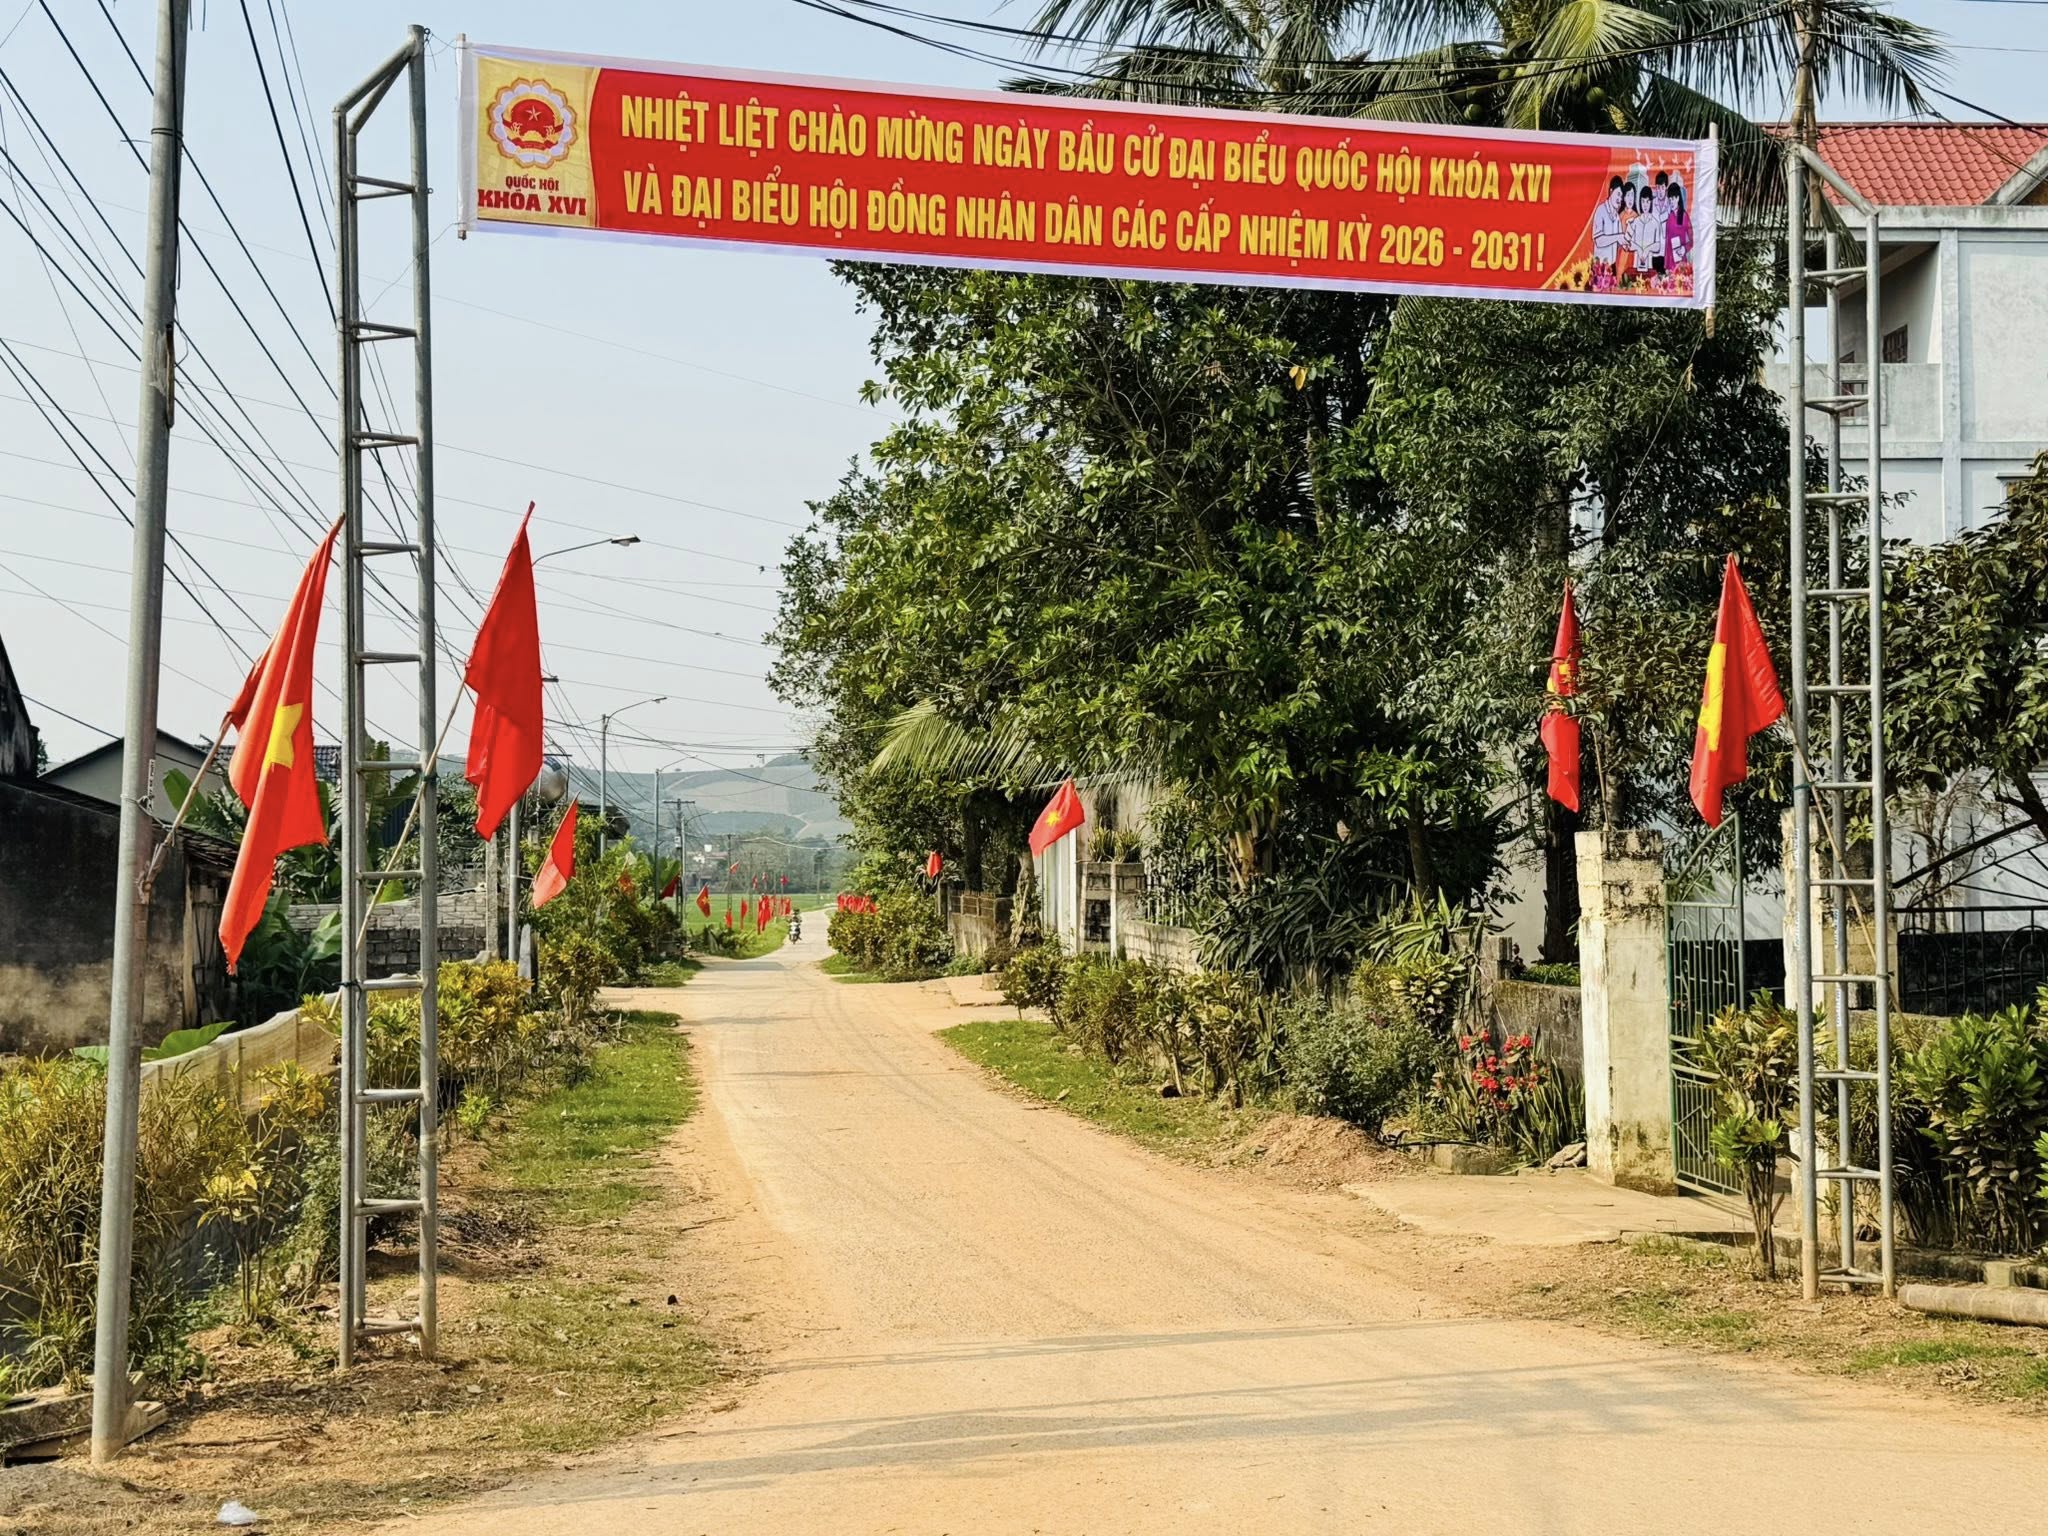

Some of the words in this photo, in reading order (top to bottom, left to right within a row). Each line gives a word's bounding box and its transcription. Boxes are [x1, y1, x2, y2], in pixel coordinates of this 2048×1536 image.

[621, 90, 710, 152] NHIỆT
[719, 96, 779, 158] LIỆT
[788, 104, 867, 157] CHÀO
[876, 110, 964, 164] MỪNG
[973, 118, 1050, 170] NGÀY
[1058, 119, 1115, 175] BẦU
[1123, 123, 1165, 178] CỬ
[1166, 137, 1216, 189] ĐẠI
[1223, 129, 1287, 186] BIỂU
[1295, 137, 1368, 192] QUỐC
[1376, 146, 1421, 204] HỘI
[1428, 150, 1500, 200] KHÓA
[1507, 162, 1552, 203] XVI
[478, 189, 541, 212] KHÓA
[548, 195, 586, 216] XVI
[505, 174, 536, 190] QUỐC
[539, 177, 559, 193] HỘI
[623, 162, 663, 215] VÀ
[669, 174, 721, 228] ĐẠI
[732, 165, 800, 226] BIỂU
[809, 178, 858, 238] HỘI
[864, 176, 946, 237] ĐỒNG
[956, 190, 1036, 242] NHÂN
[1045, 195, 1103, 246] DÂN
[1112, 198, 1167, 250] CÁC
[1176, 197, 1231, 253] CẤP
[1239, 209, 1329, 267] NHIỆM
[1337, 212, 1373, 262] KỲ
[1379, 224, 1444, 267] 2026
[1452, 246, 1463, 255] -
[1470, 229, 1545, 272] 2031!
